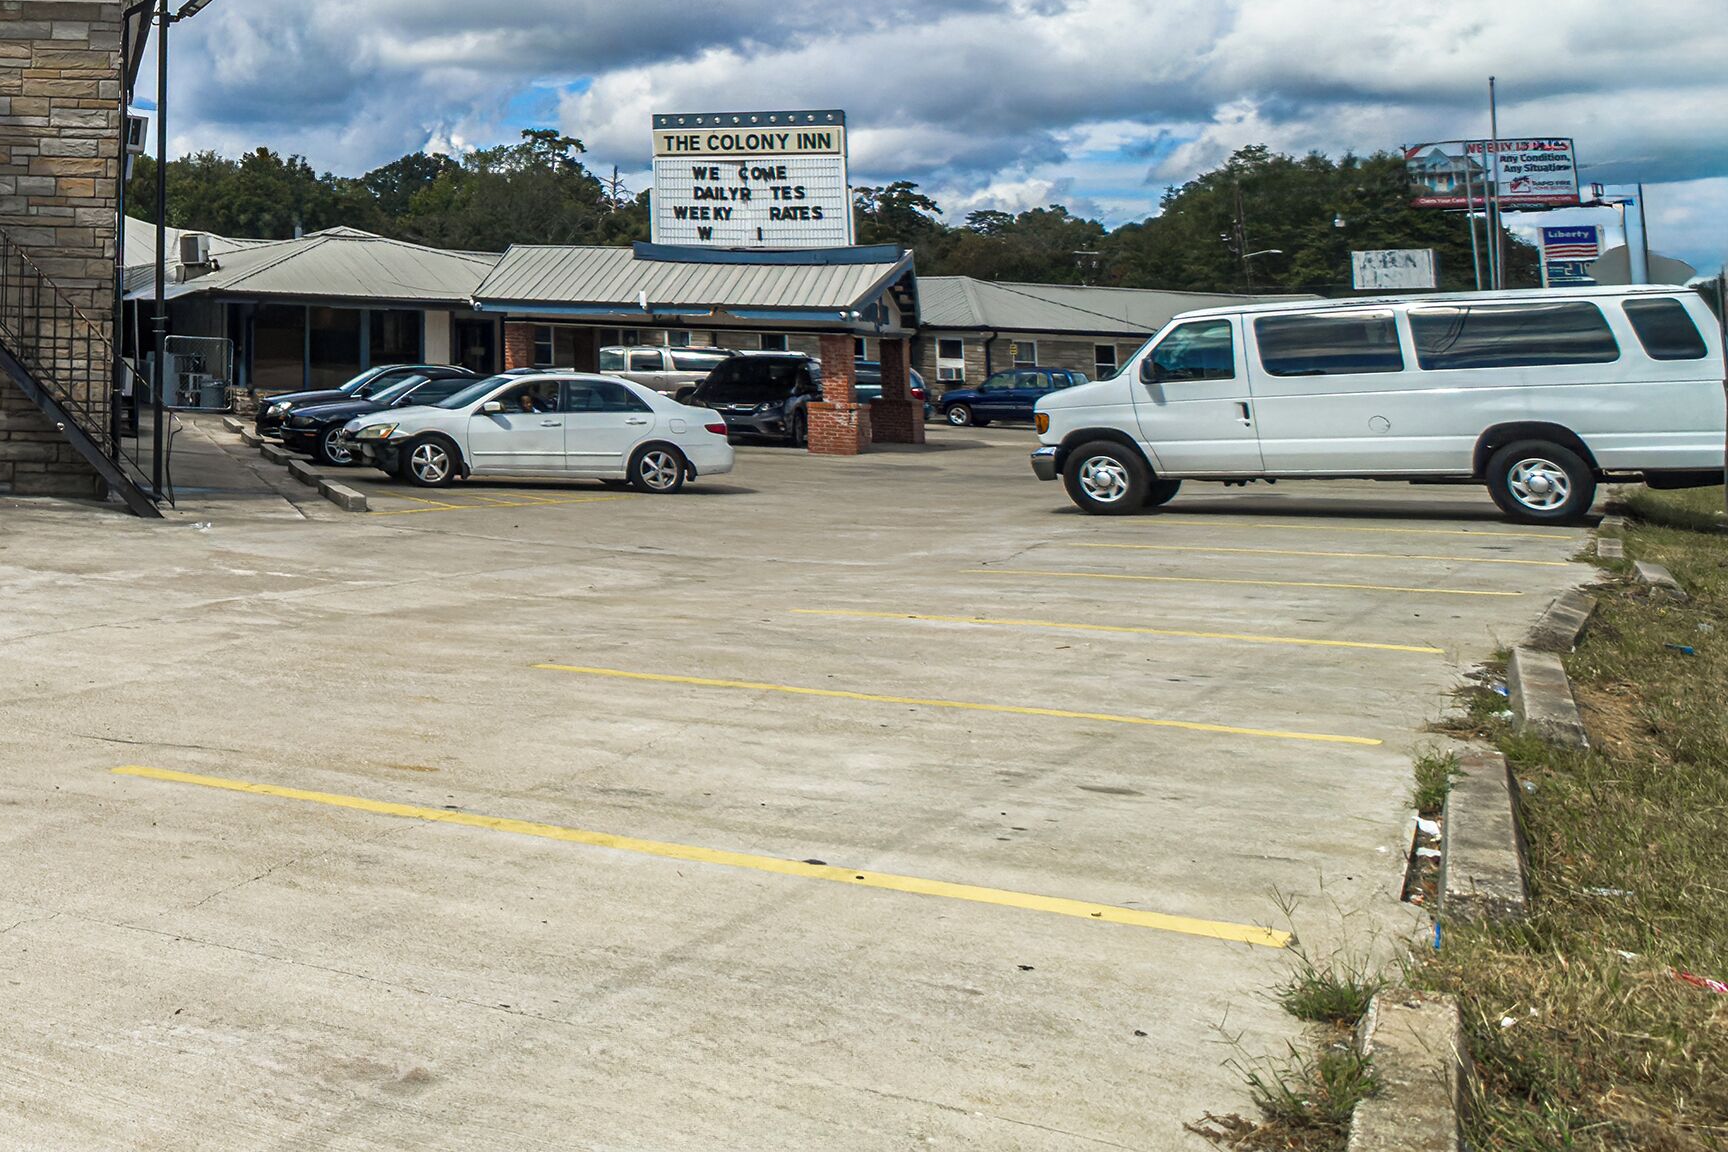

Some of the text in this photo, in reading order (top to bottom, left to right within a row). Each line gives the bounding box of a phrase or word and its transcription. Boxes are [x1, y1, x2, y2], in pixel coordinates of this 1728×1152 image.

[663, 132, 832, 152] THE COLONY INN
[1499, 153, 1519, 163] Any
[692, 166, 720, 181] WE
[1503, 164, 1523, 174] Any
[769, 205, 824, 221] RATES
[697, 226, 713, 241] W
[1547, 230, 1590, 239] Liberty
